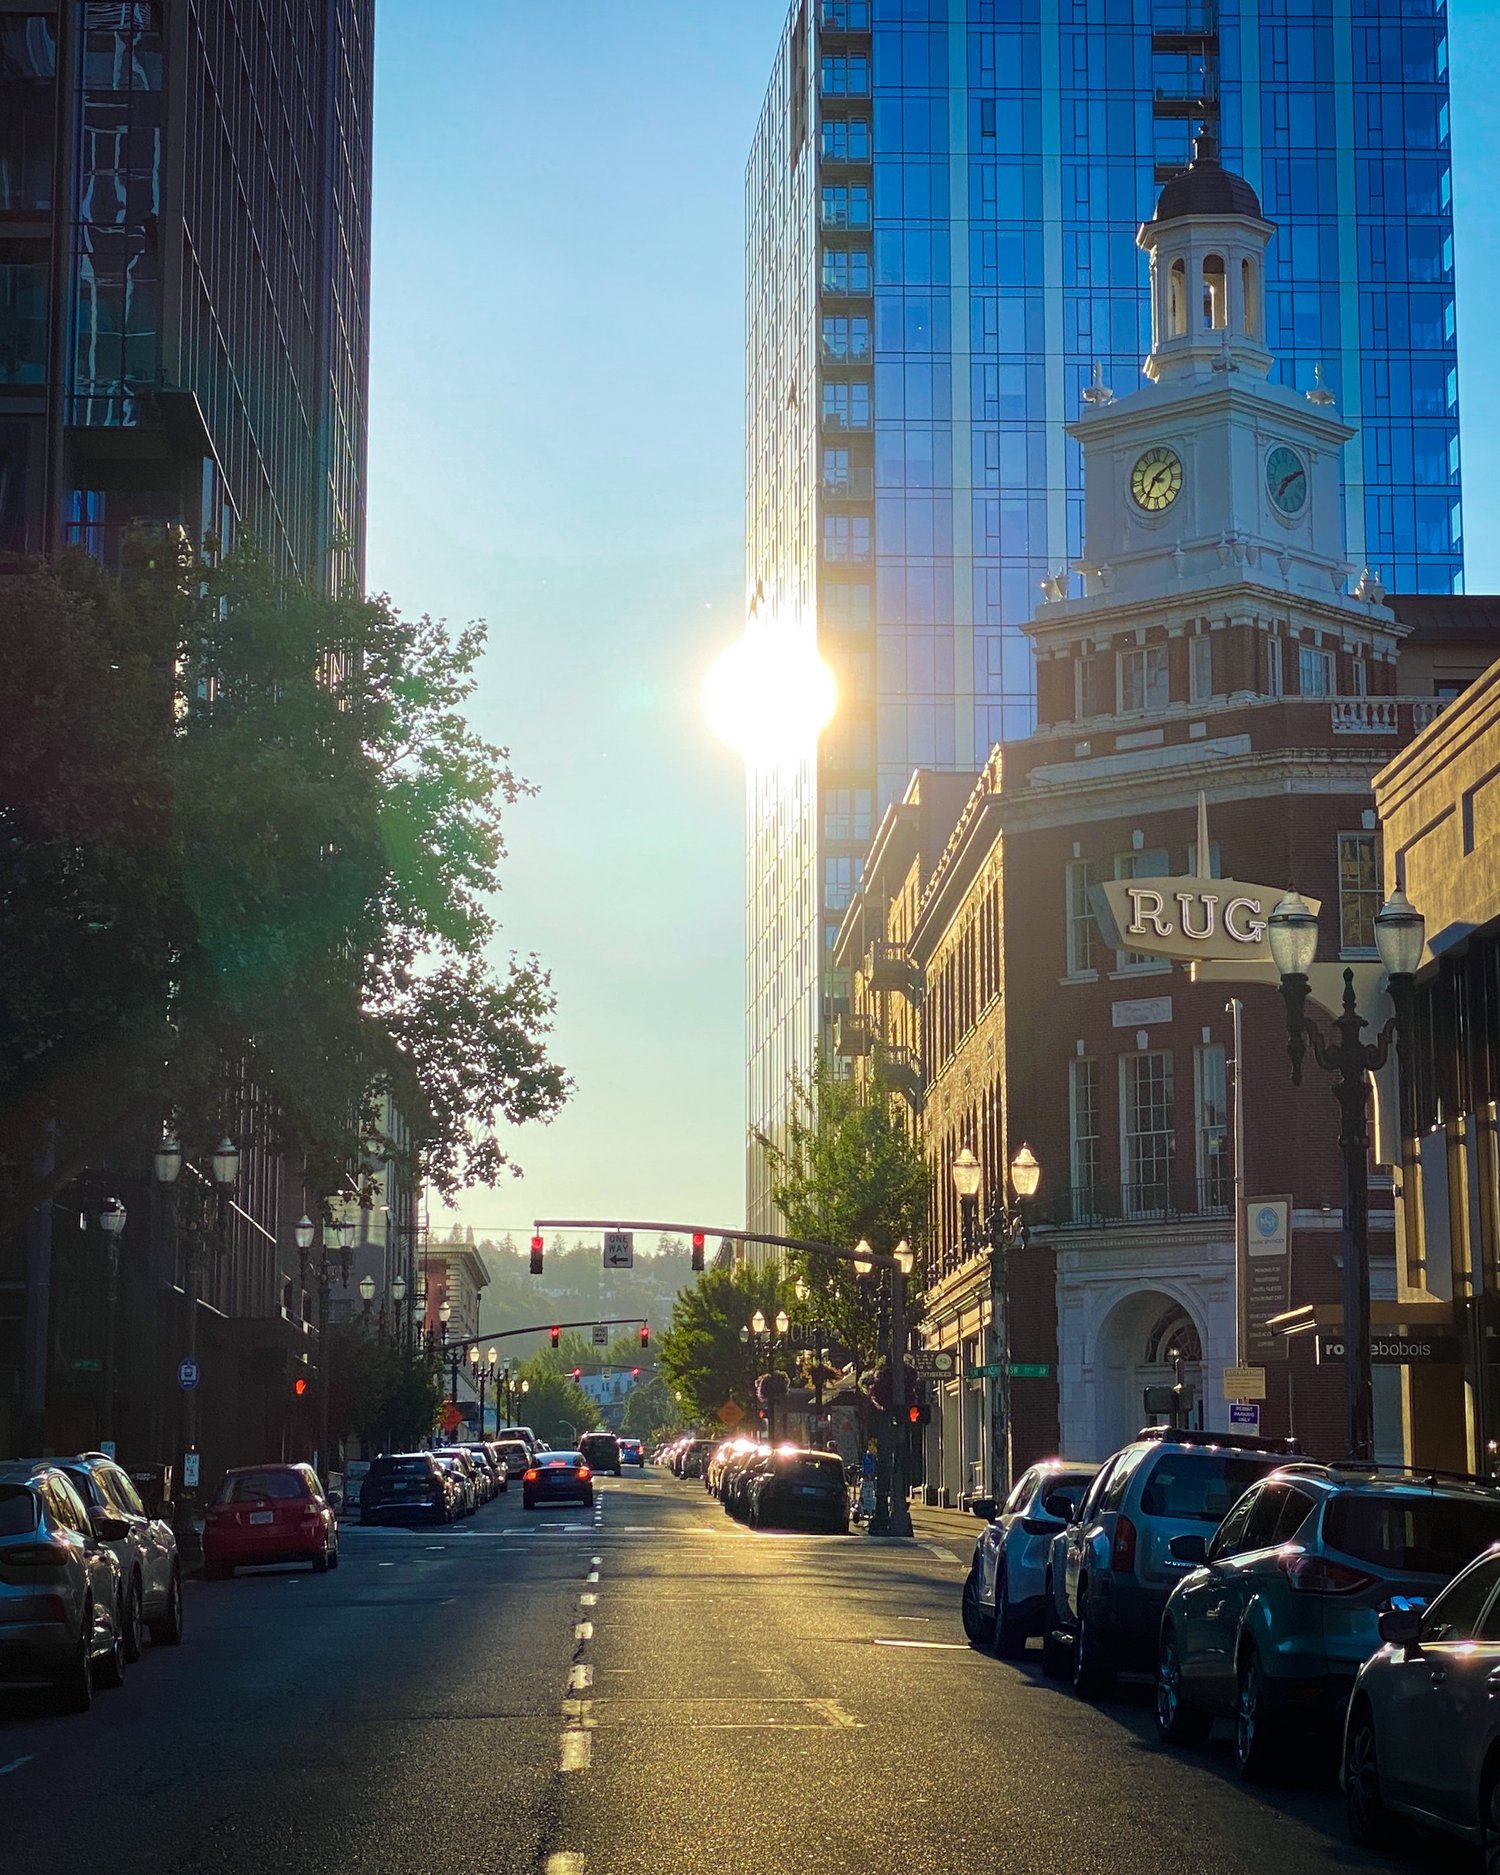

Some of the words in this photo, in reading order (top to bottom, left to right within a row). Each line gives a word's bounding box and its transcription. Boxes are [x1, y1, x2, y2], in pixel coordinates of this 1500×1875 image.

[1127, 888, 1268, 943] RUG
[609, 1234, 628, 1243] ONE
[609, 1244, 629, 1253] WAY
[1325, 1341, 1431, 1356] roebobois
[1009, 1367, 1019, 1375] SW
